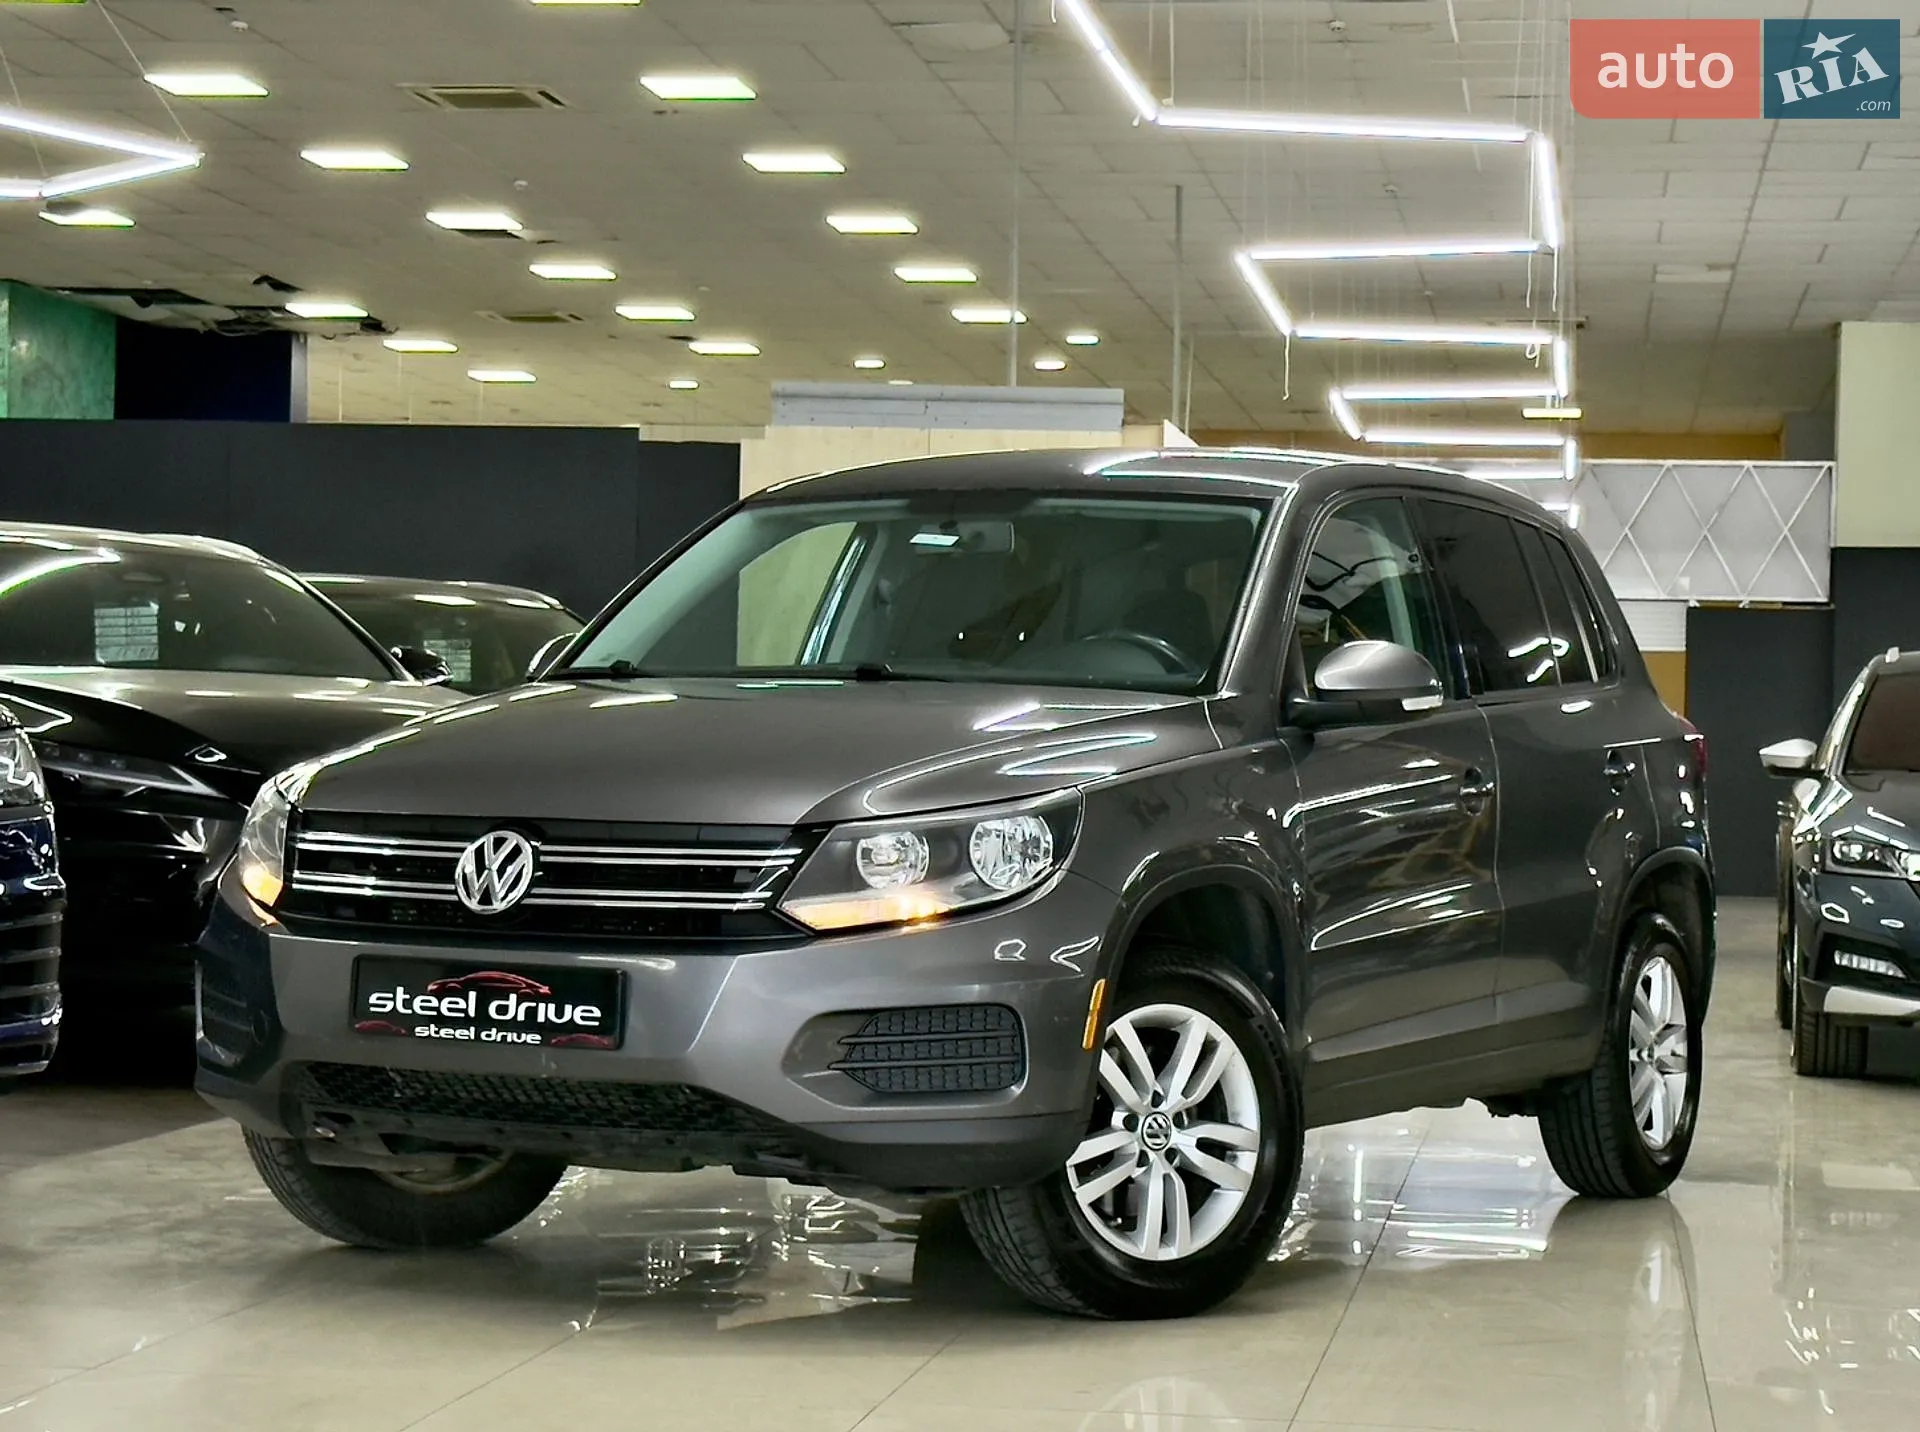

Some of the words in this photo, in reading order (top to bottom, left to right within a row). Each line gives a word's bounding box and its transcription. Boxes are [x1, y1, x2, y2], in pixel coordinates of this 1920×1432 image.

[368, 986, 476, 1018] steel
[488, 993, 602, 1026] drive
[414, 1023, 475, 1040] steel
[480, 1028, 542, 1045] drive
